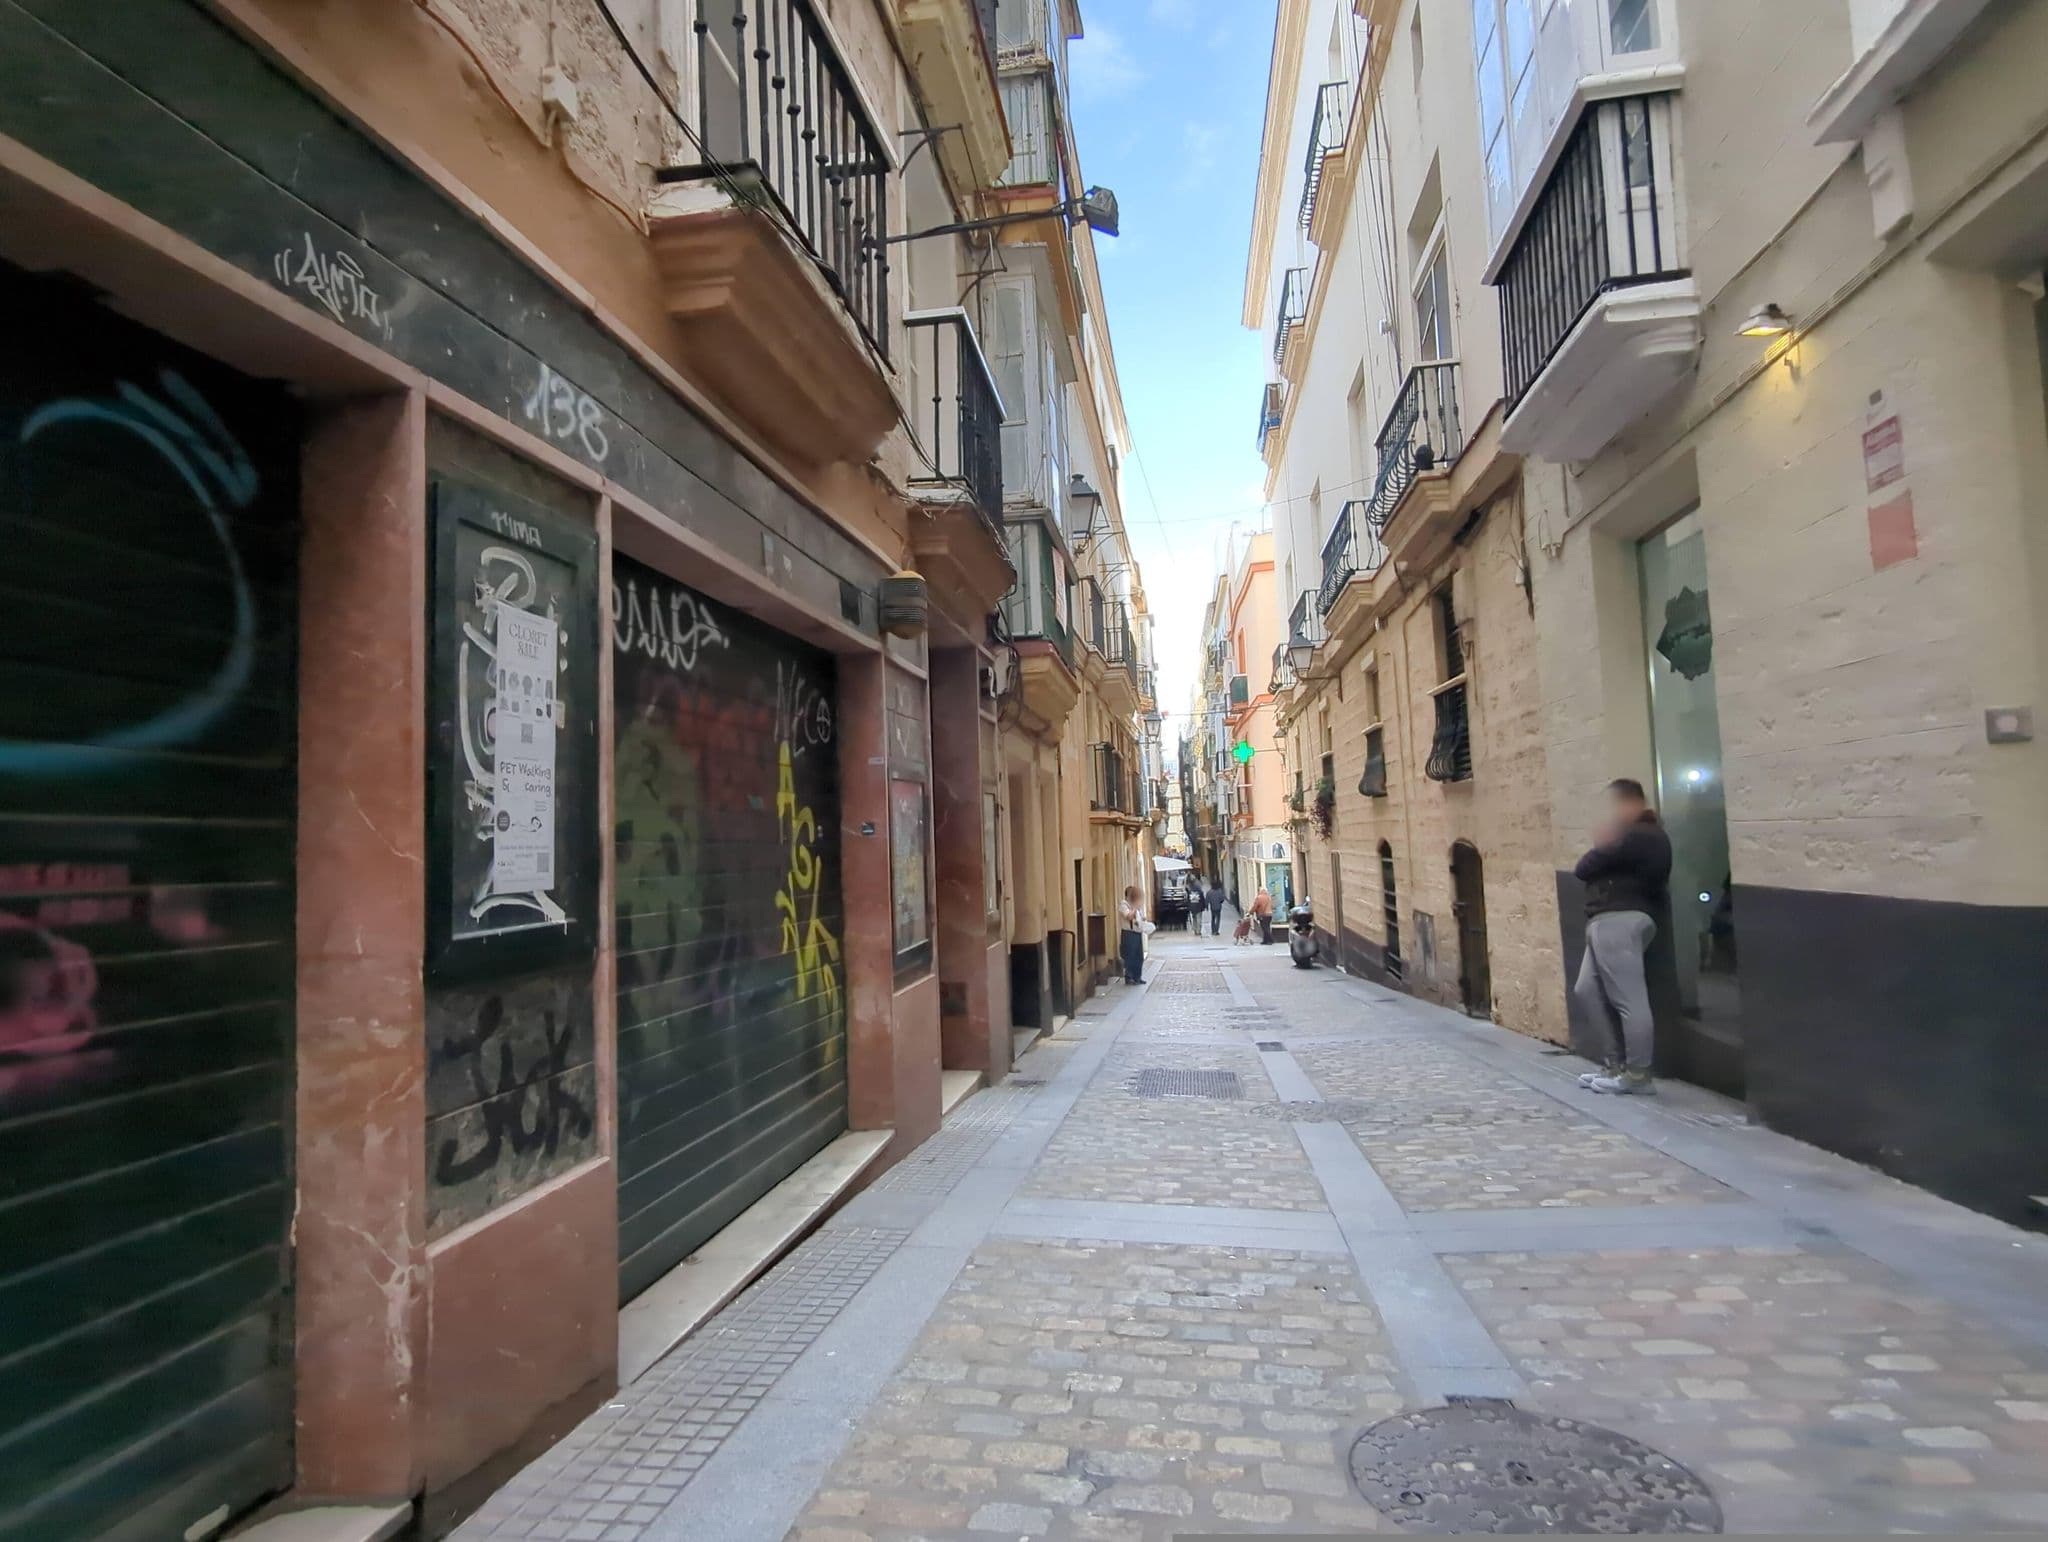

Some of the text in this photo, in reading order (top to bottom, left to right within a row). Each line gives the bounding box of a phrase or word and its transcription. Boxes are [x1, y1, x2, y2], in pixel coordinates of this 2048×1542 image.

[500, 761, 552, 780] PET Walking
[524, 781, 552, 798] caring
